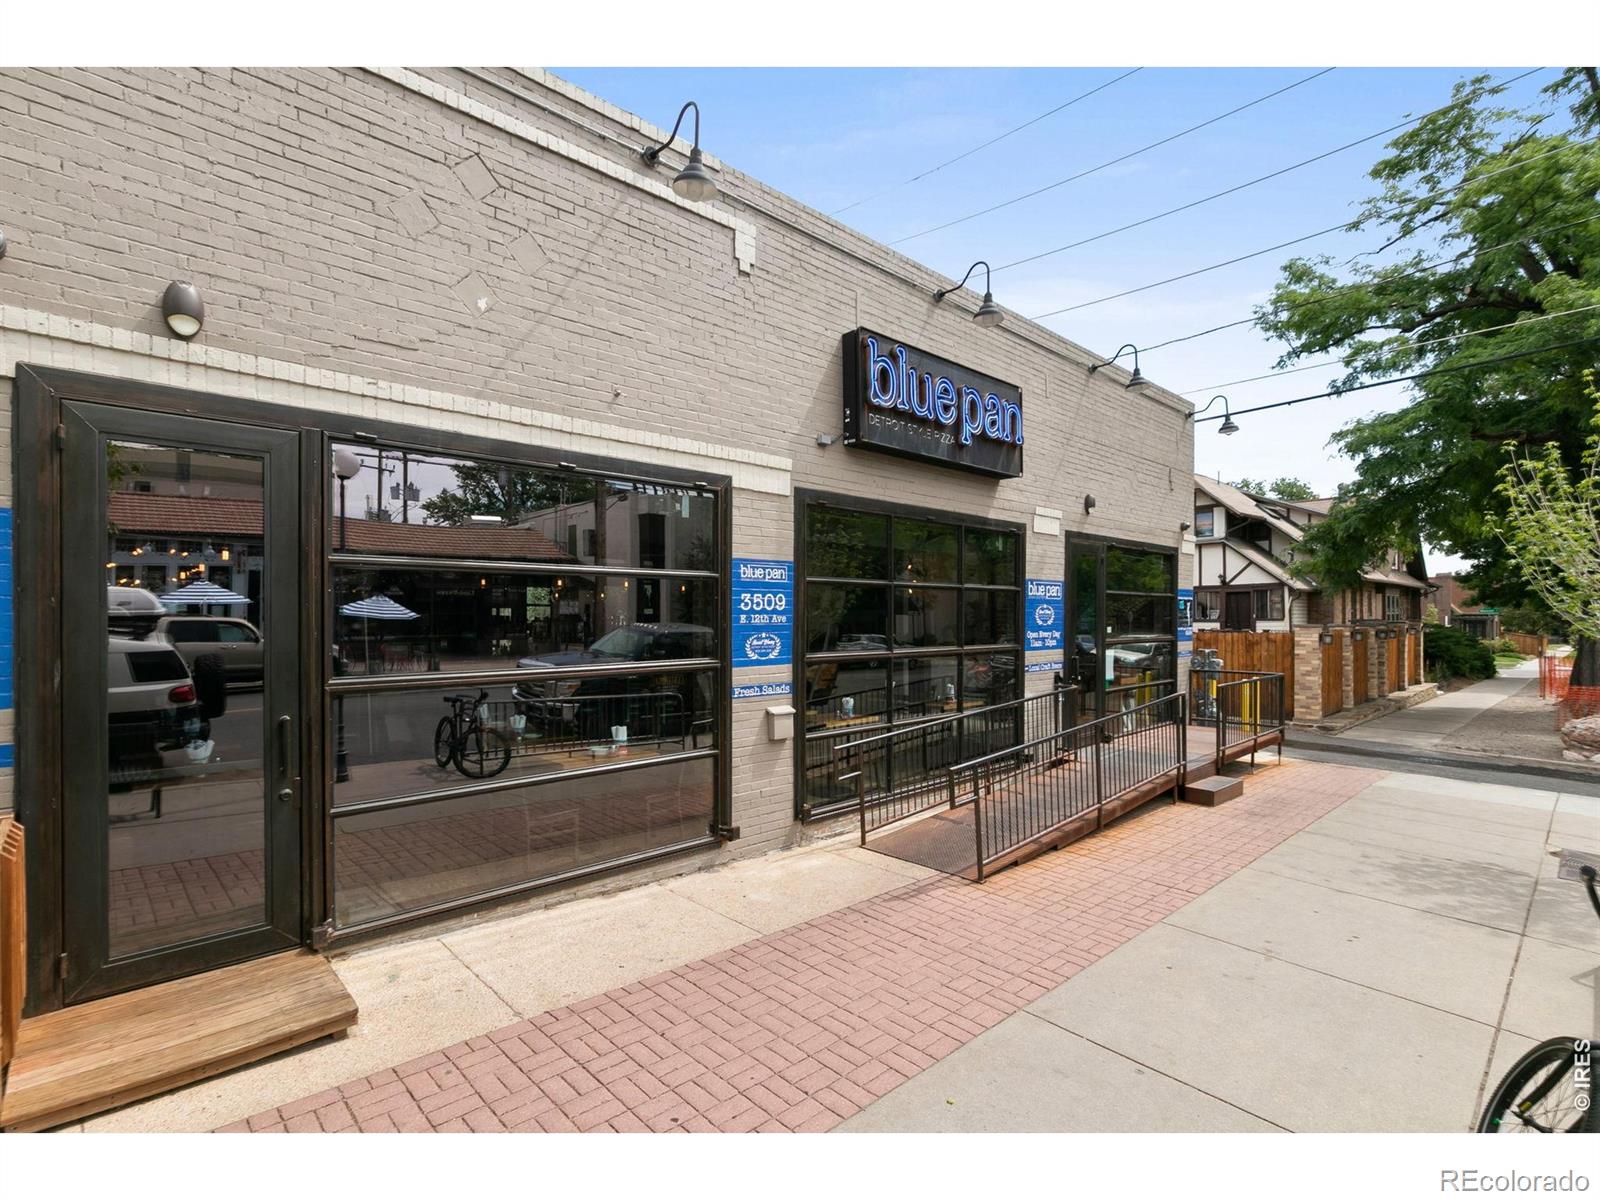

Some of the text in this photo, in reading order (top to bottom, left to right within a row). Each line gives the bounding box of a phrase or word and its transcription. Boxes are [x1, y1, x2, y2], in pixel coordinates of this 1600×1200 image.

[866, 336, 1024, 446] blue pan
[868, 412, 905, 432] DETROT
[934, 430, 956, 445] PZZA
[740, 564, 786, 582] blue pan
[1028, 581, 1061, 599] blue pan
[741, 593, 786, 611] 3509
[740, 614, 787, 624] E. 12th Ave
[1026, 631, 1038, 640] Open
[733, 684, 790, 697] Fresh Salads
